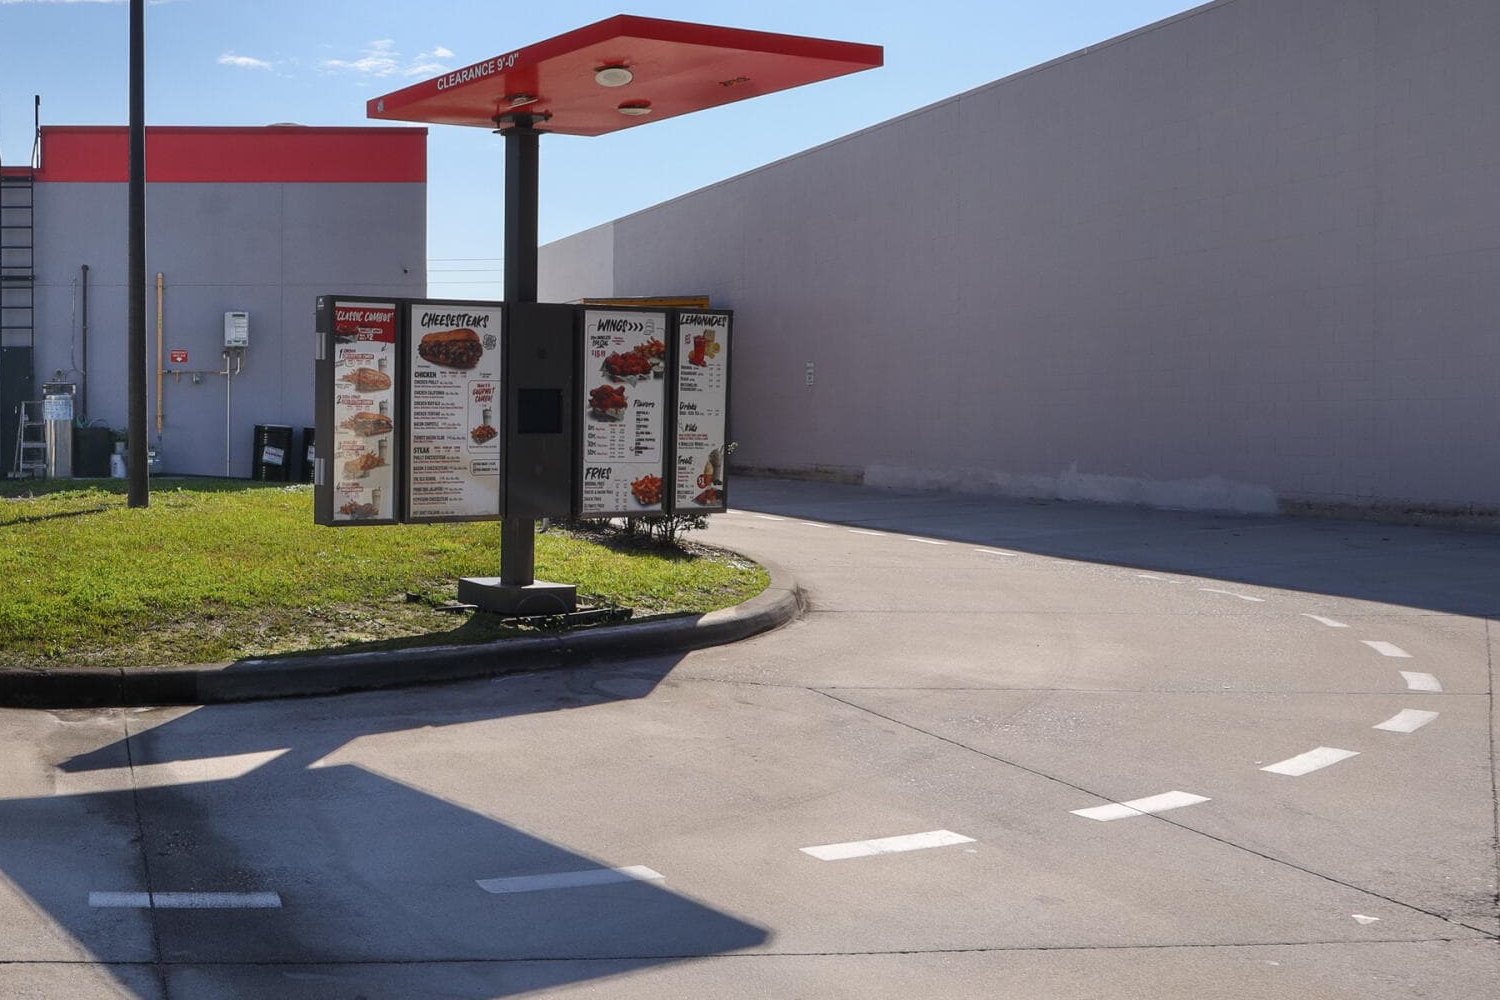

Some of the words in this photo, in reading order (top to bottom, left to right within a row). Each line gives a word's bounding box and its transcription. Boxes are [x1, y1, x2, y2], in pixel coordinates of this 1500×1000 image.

[437, 63, 495, 90] CLEARANCE
[497, 53, 519, 71] 9'-0"
[421, 312, 489, 328] CHEESESTEAKS
[597, 319, 627, 333] WINGS
[680, 315, 727, 327] LEMONADES
[633, 400, 655, 408] Flavors
[585, 467, 612, 480] FRIES
